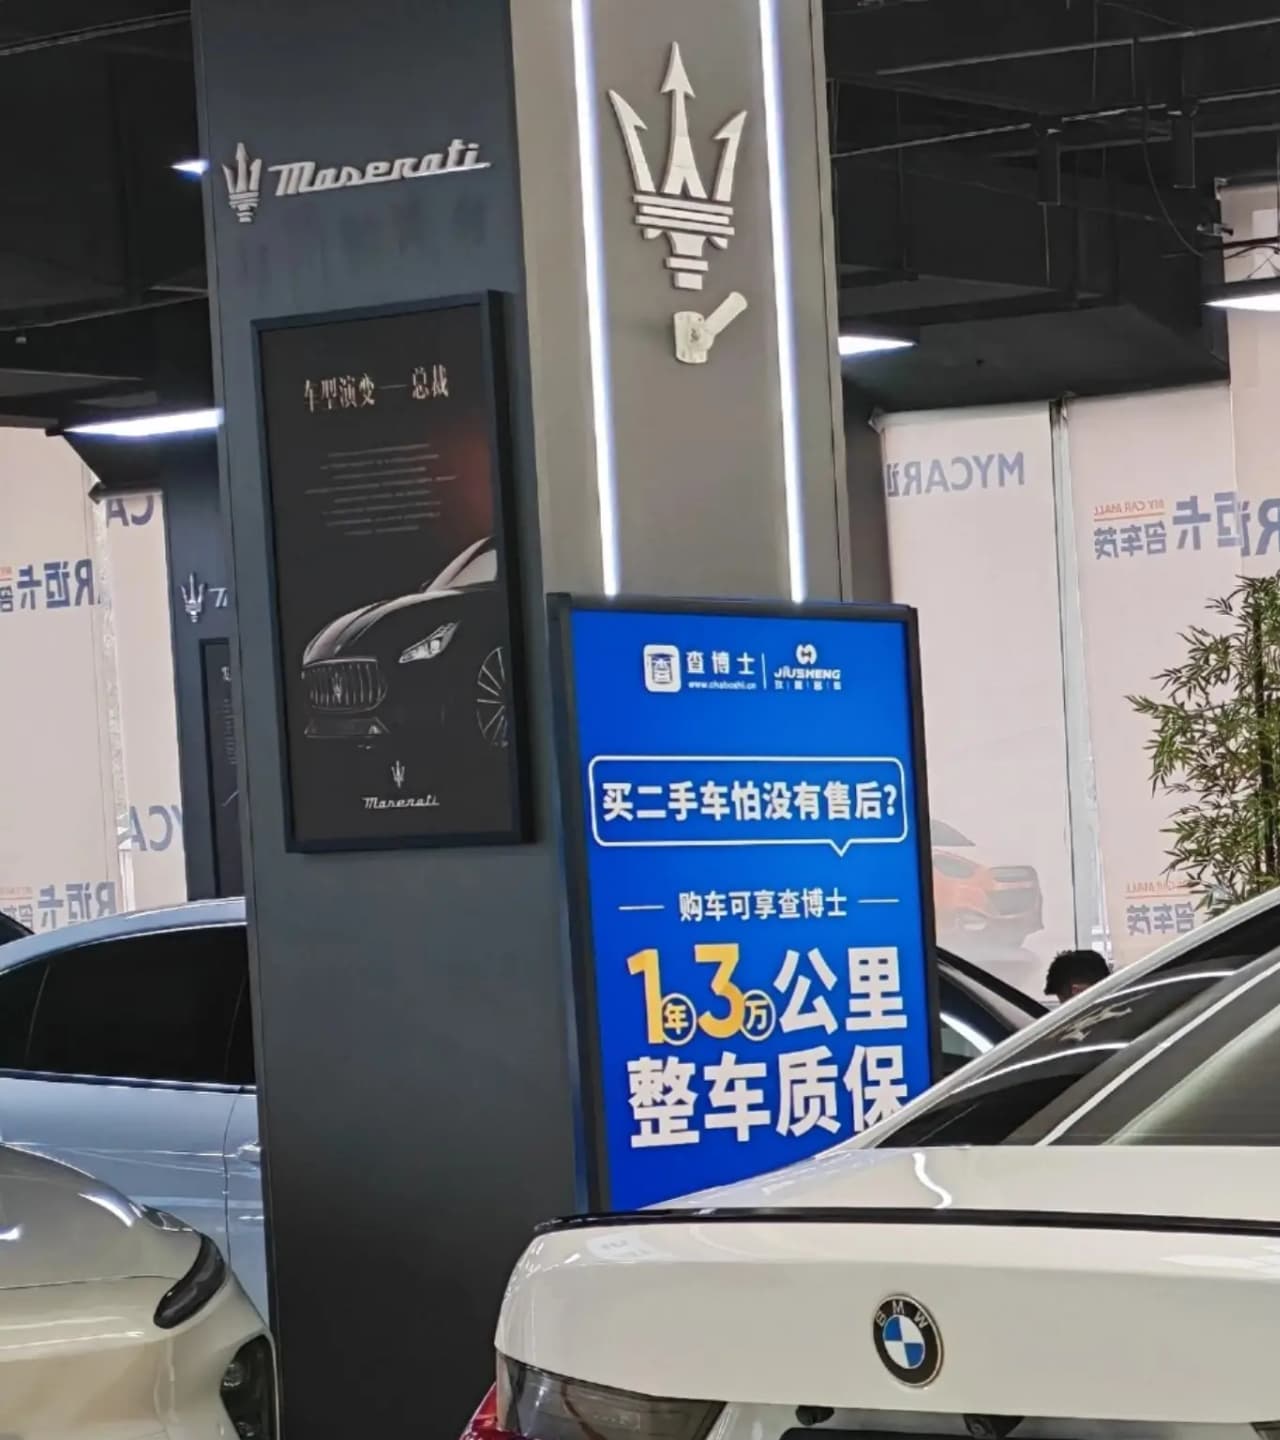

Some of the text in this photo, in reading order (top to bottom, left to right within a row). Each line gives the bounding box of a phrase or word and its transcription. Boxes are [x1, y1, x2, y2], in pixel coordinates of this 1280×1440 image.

[268, 139, 491, 197] Maserati
[678, 887, 848, 923] 购车可享查博士
[627, 1045, 908, 1148] 整车质保
